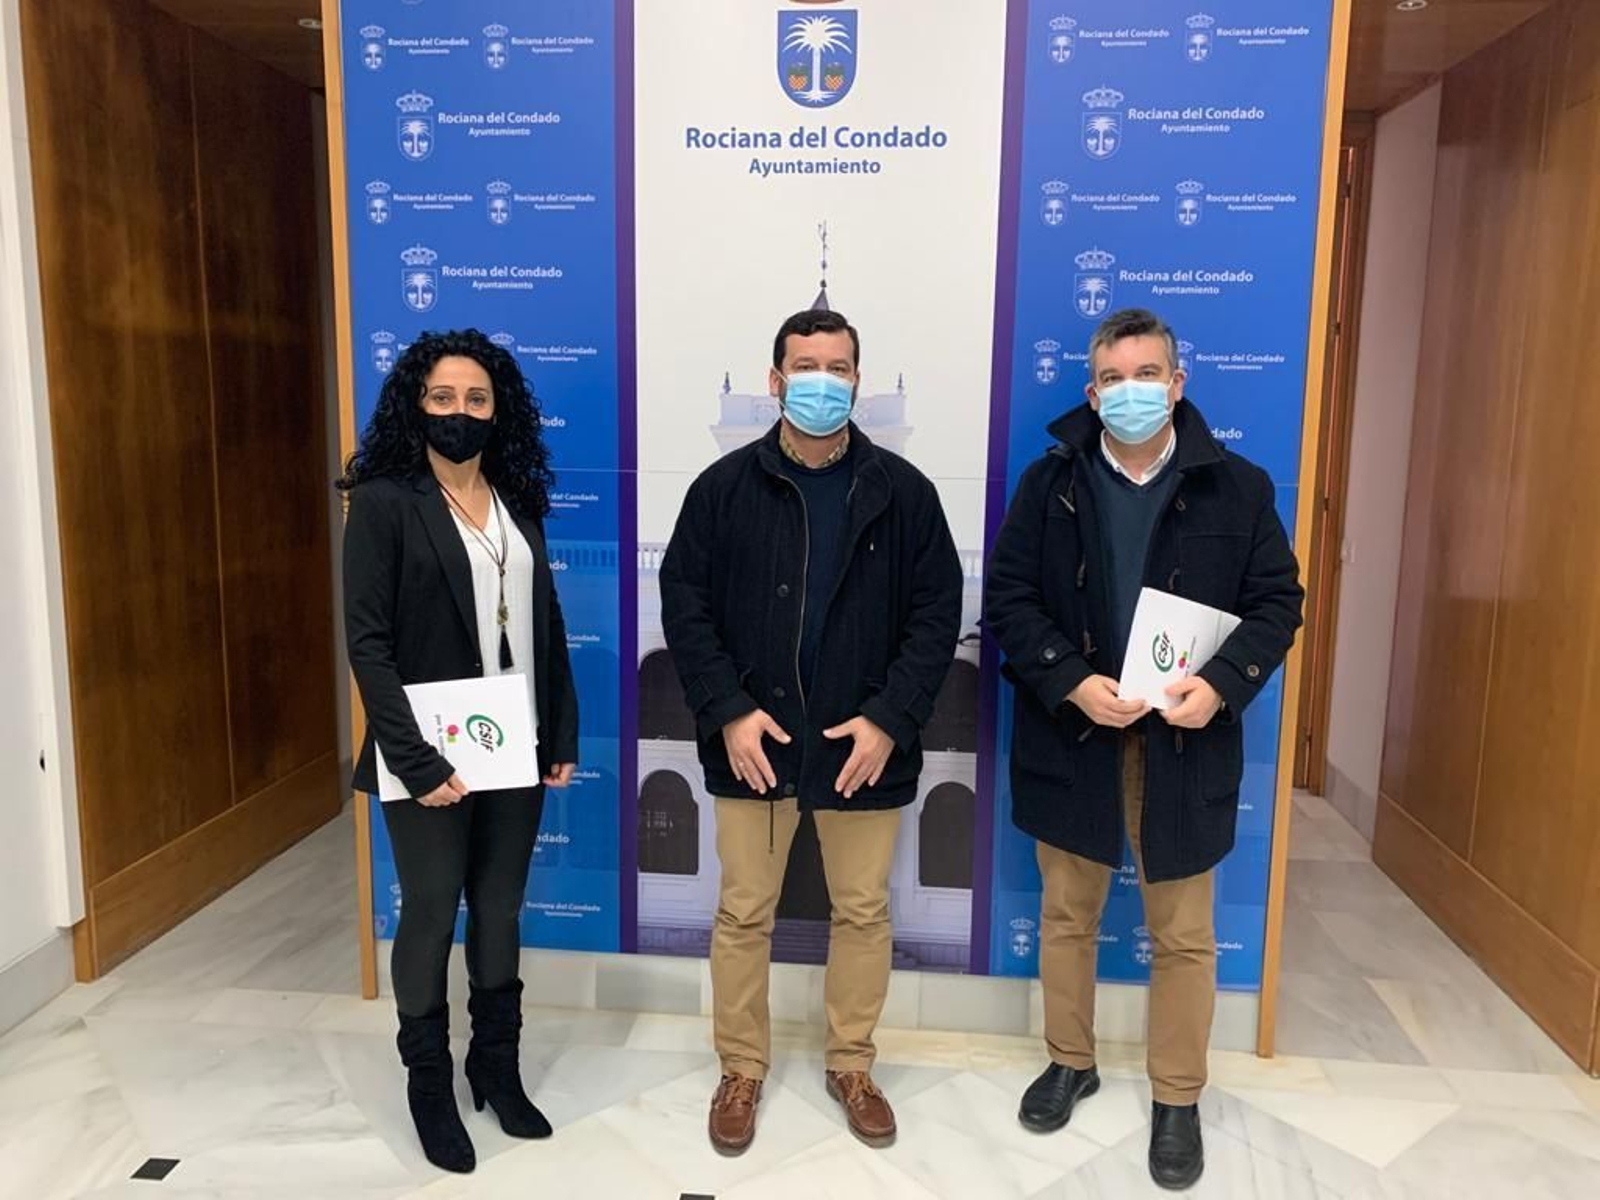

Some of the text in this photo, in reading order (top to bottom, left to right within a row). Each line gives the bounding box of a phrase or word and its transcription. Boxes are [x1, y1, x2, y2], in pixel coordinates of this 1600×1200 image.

[1079, 29, 1169, 39] Rociana del Condado
[1217, 26, 1309, 37] Rociana del Condado
[388, 37, 469, 47] Rociana del Condado
[511, 36, 594, 46] Rociana del Condado
[438, 111, 561, 124] Rociana del Condado
[1128, 107, 1264, 120] Rociana del Condado
[468, 126, 531, 138] Ayuntamiento
[1161, 123, 1230, 134] Ayuntamiento
[686, 125, 947, 149] Rociana del Condado
[749, 158, 881, 178] Ayuntamiento
[393, 193, 473, 202] Rociana del Condado
[514, 193, 595, 202] Rociana del Condado
[1071, 193, 1160, 203] Rociana del Condado
[1206, 193, 1296, 203] Rociana del Condado
[442, 266, 563, 278] Rociana del Condado
[1119, 270, 1253, 282] Rociana del Condado
[472, 280, 533, 291] Ayuntamiento
[1152, 284, 1220, 295] Ayuntamiento
[1196, 354, 1285, 364] Rociana del Condado
[477, 722, 494, 755] CSIF
[537, 833, 569, 844] ndado
